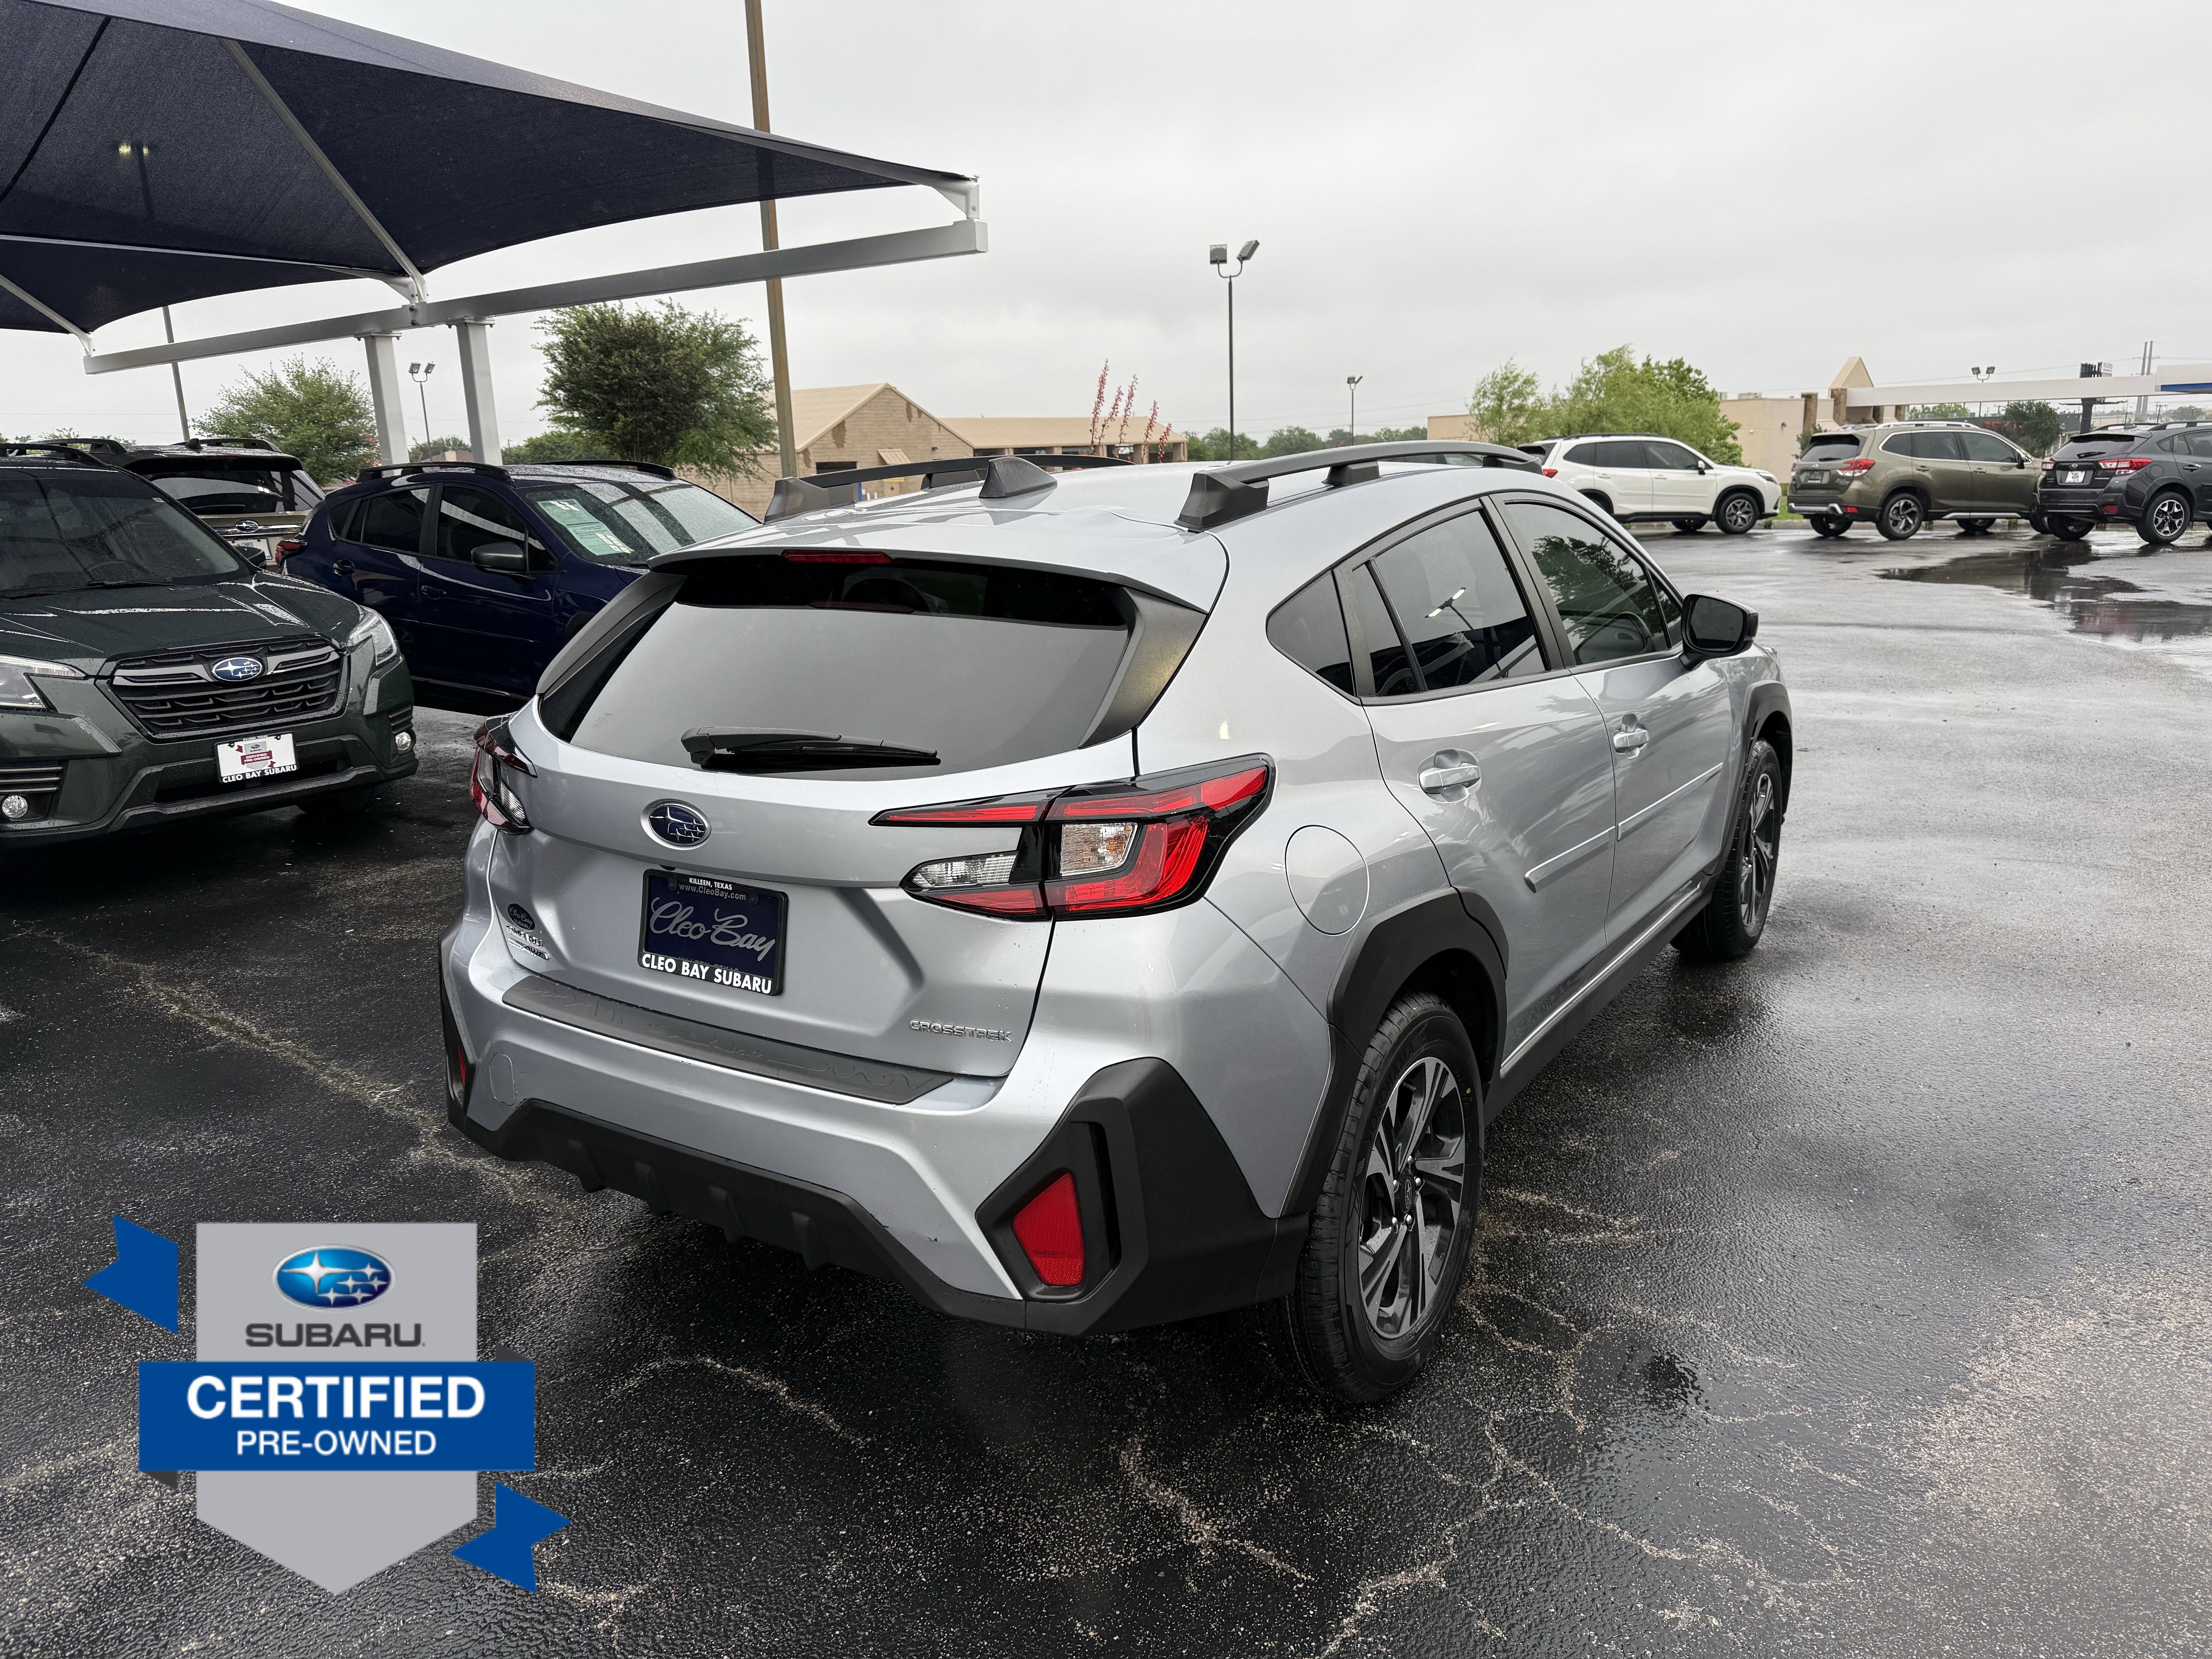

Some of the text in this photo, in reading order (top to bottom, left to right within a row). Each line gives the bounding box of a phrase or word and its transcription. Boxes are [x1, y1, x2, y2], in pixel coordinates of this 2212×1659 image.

[222, 764, 297, 783] CLEO BAY SUBARU
[679, 883, 746, 901] www.CleoBay.com
[689, 877, 732, 890] KILLEEN, TEXAS
[650, 896, 775, 962] Cleo Bay
[642, 953, 676, 973] CLEO
[681, 962, 709, 979] BAY
[714, 969, 772, 994] SUBARU
[909, 1020, 1014, 1043] CROSSTREK
